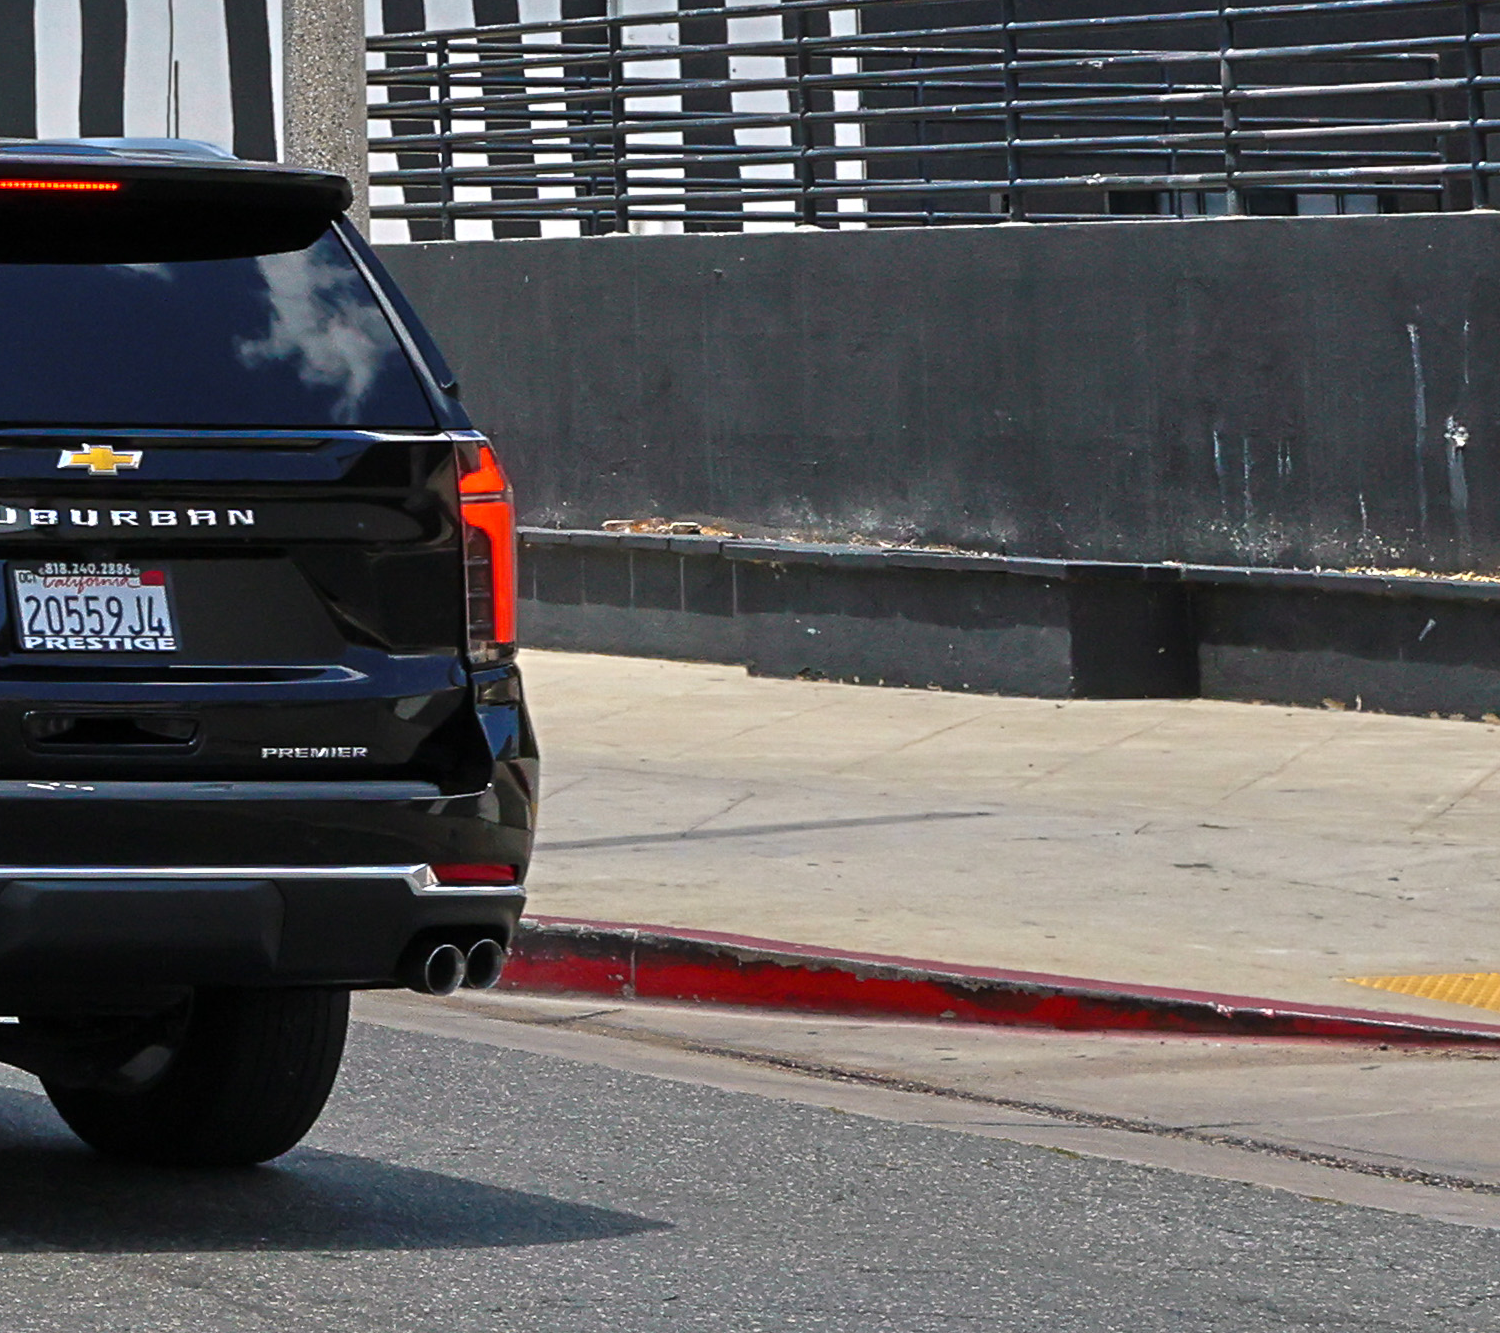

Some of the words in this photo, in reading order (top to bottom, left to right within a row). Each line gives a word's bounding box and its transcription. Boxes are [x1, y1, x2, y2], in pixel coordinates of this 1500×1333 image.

[43, 562, 132, 576] 818.240.2886
[23, 636, 178, 651] PRESTIGE
[260, 745, 369, 760] PREMIER
